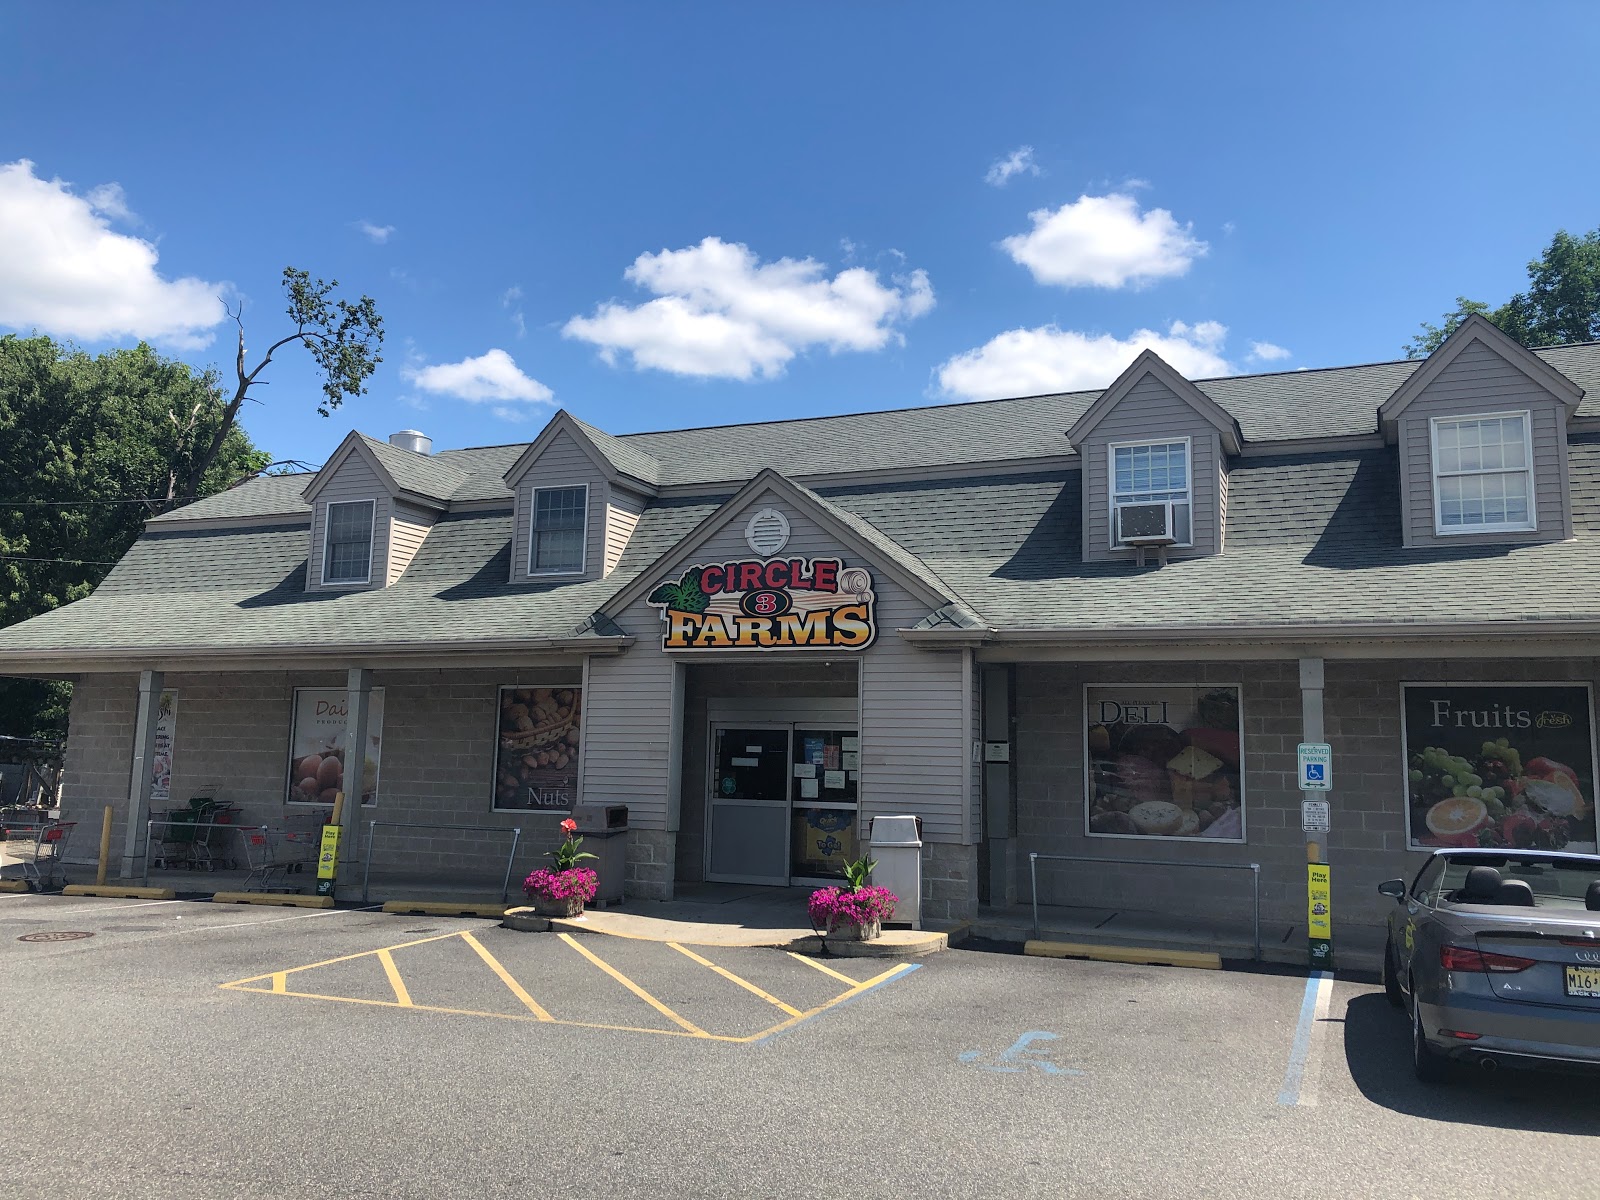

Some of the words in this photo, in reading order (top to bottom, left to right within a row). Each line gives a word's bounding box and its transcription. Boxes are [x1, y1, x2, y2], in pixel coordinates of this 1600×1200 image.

[701, 562, 837, 594] CIRCLE
[755, 593, 777, 613] 3
[667, 603, 870, 646] FARMS
[316, 699, 348, 716] Dai
[1099, 700, 1170, 724] DELI
[1430, 700, 1532, 728] Fruits
[527, 787, 569, 806] Nuts
